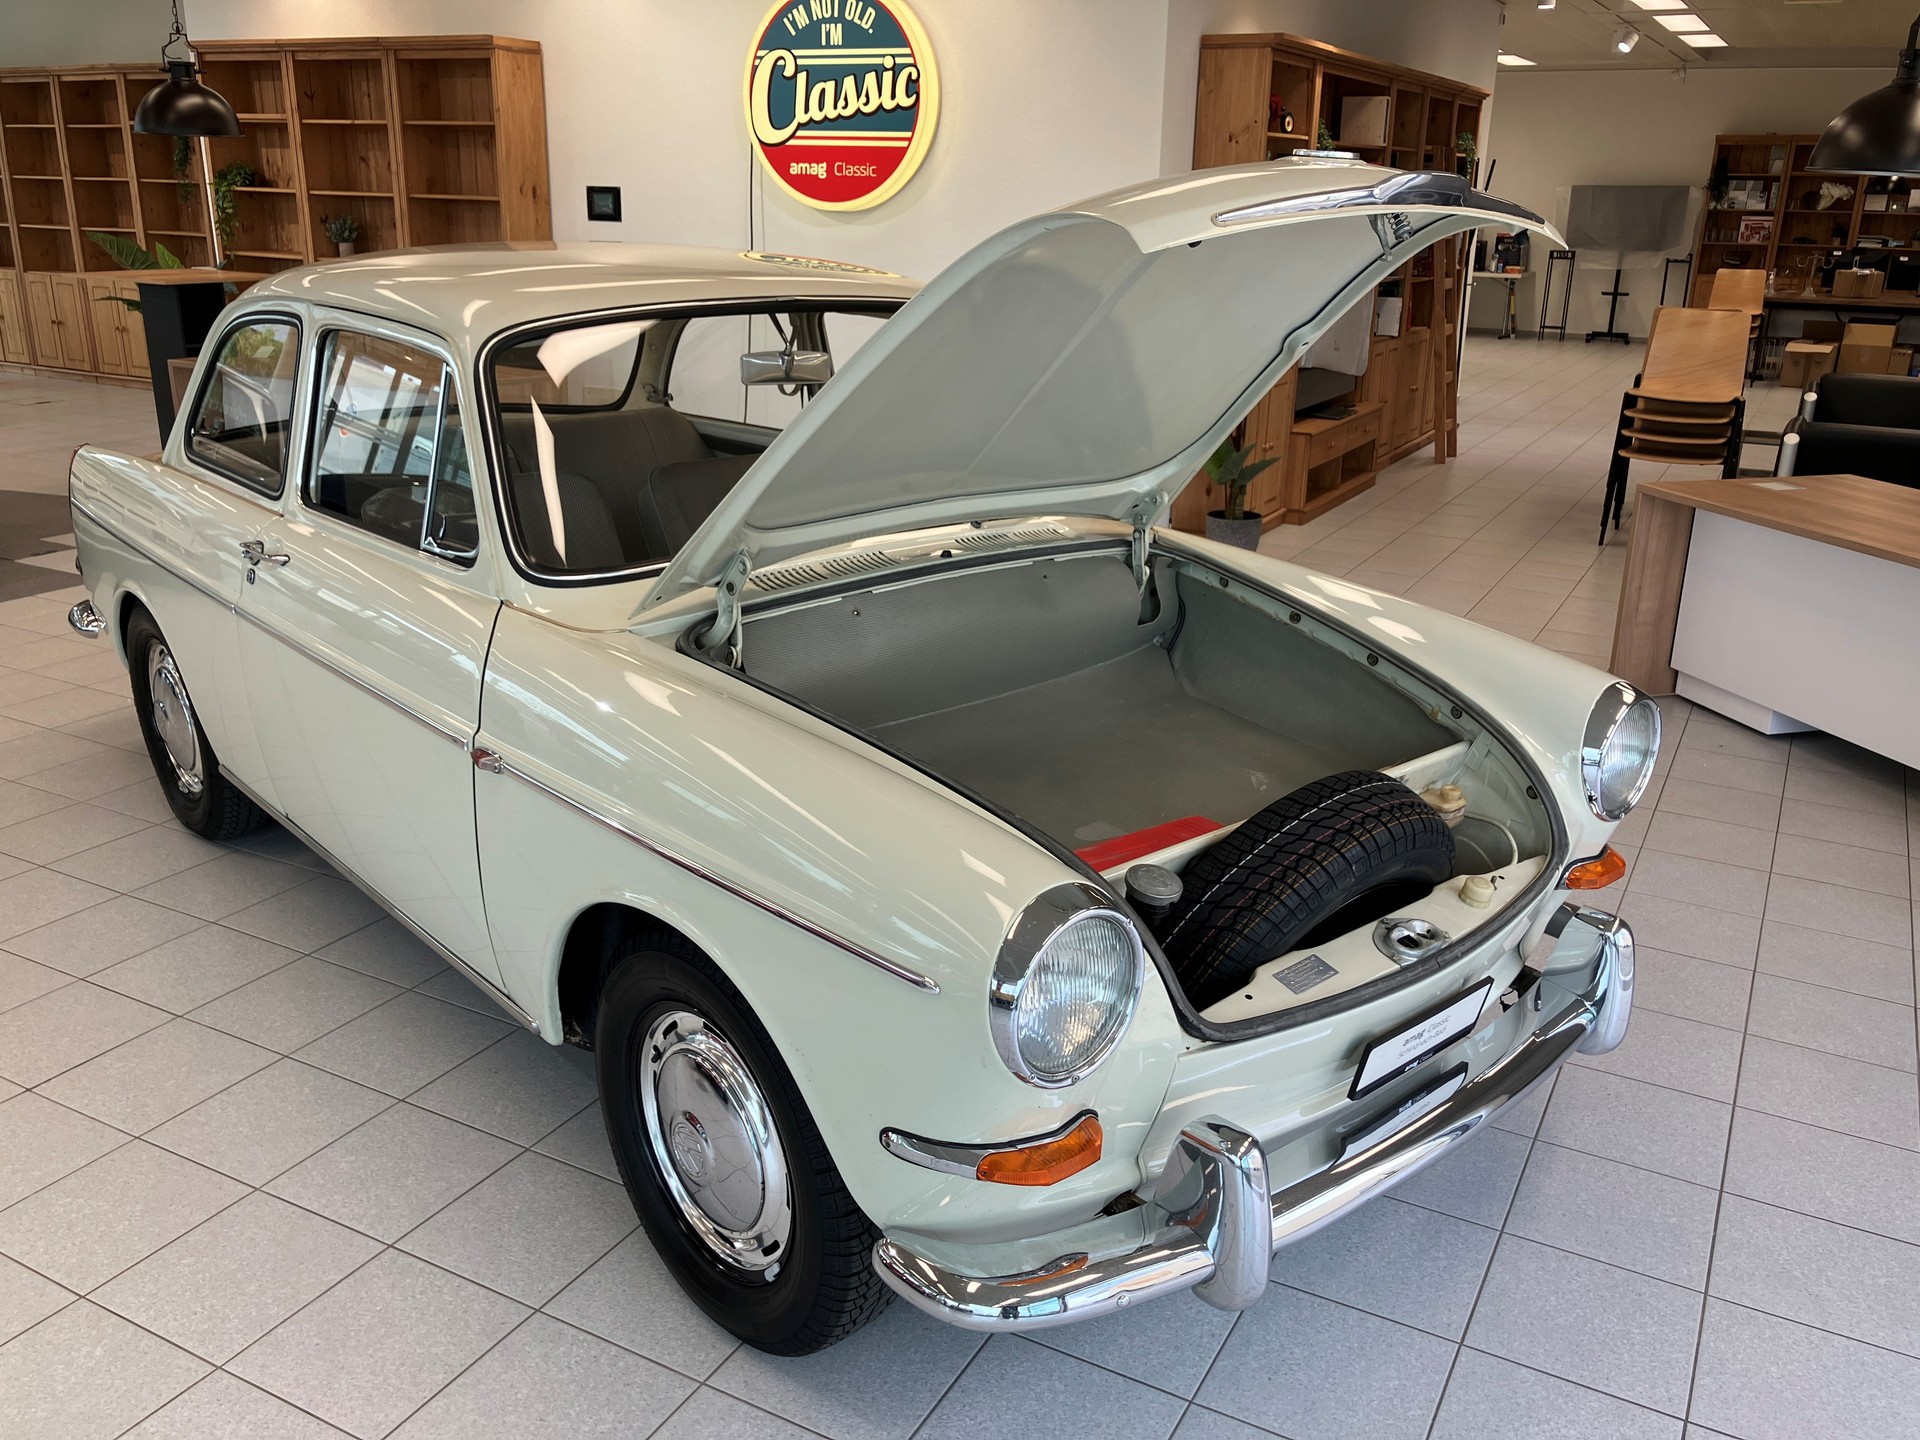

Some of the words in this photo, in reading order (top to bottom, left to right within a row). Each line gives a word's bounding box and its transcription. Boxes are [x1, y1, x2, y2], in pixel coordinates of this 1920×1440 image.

[783, 4, 809, 36] I'M
[821, 23, 843, 46] I'M
[751, 48, 919, 146] Classic
[789, 162, 827, 179] amag
[833, 162, 877, 177] Classic
